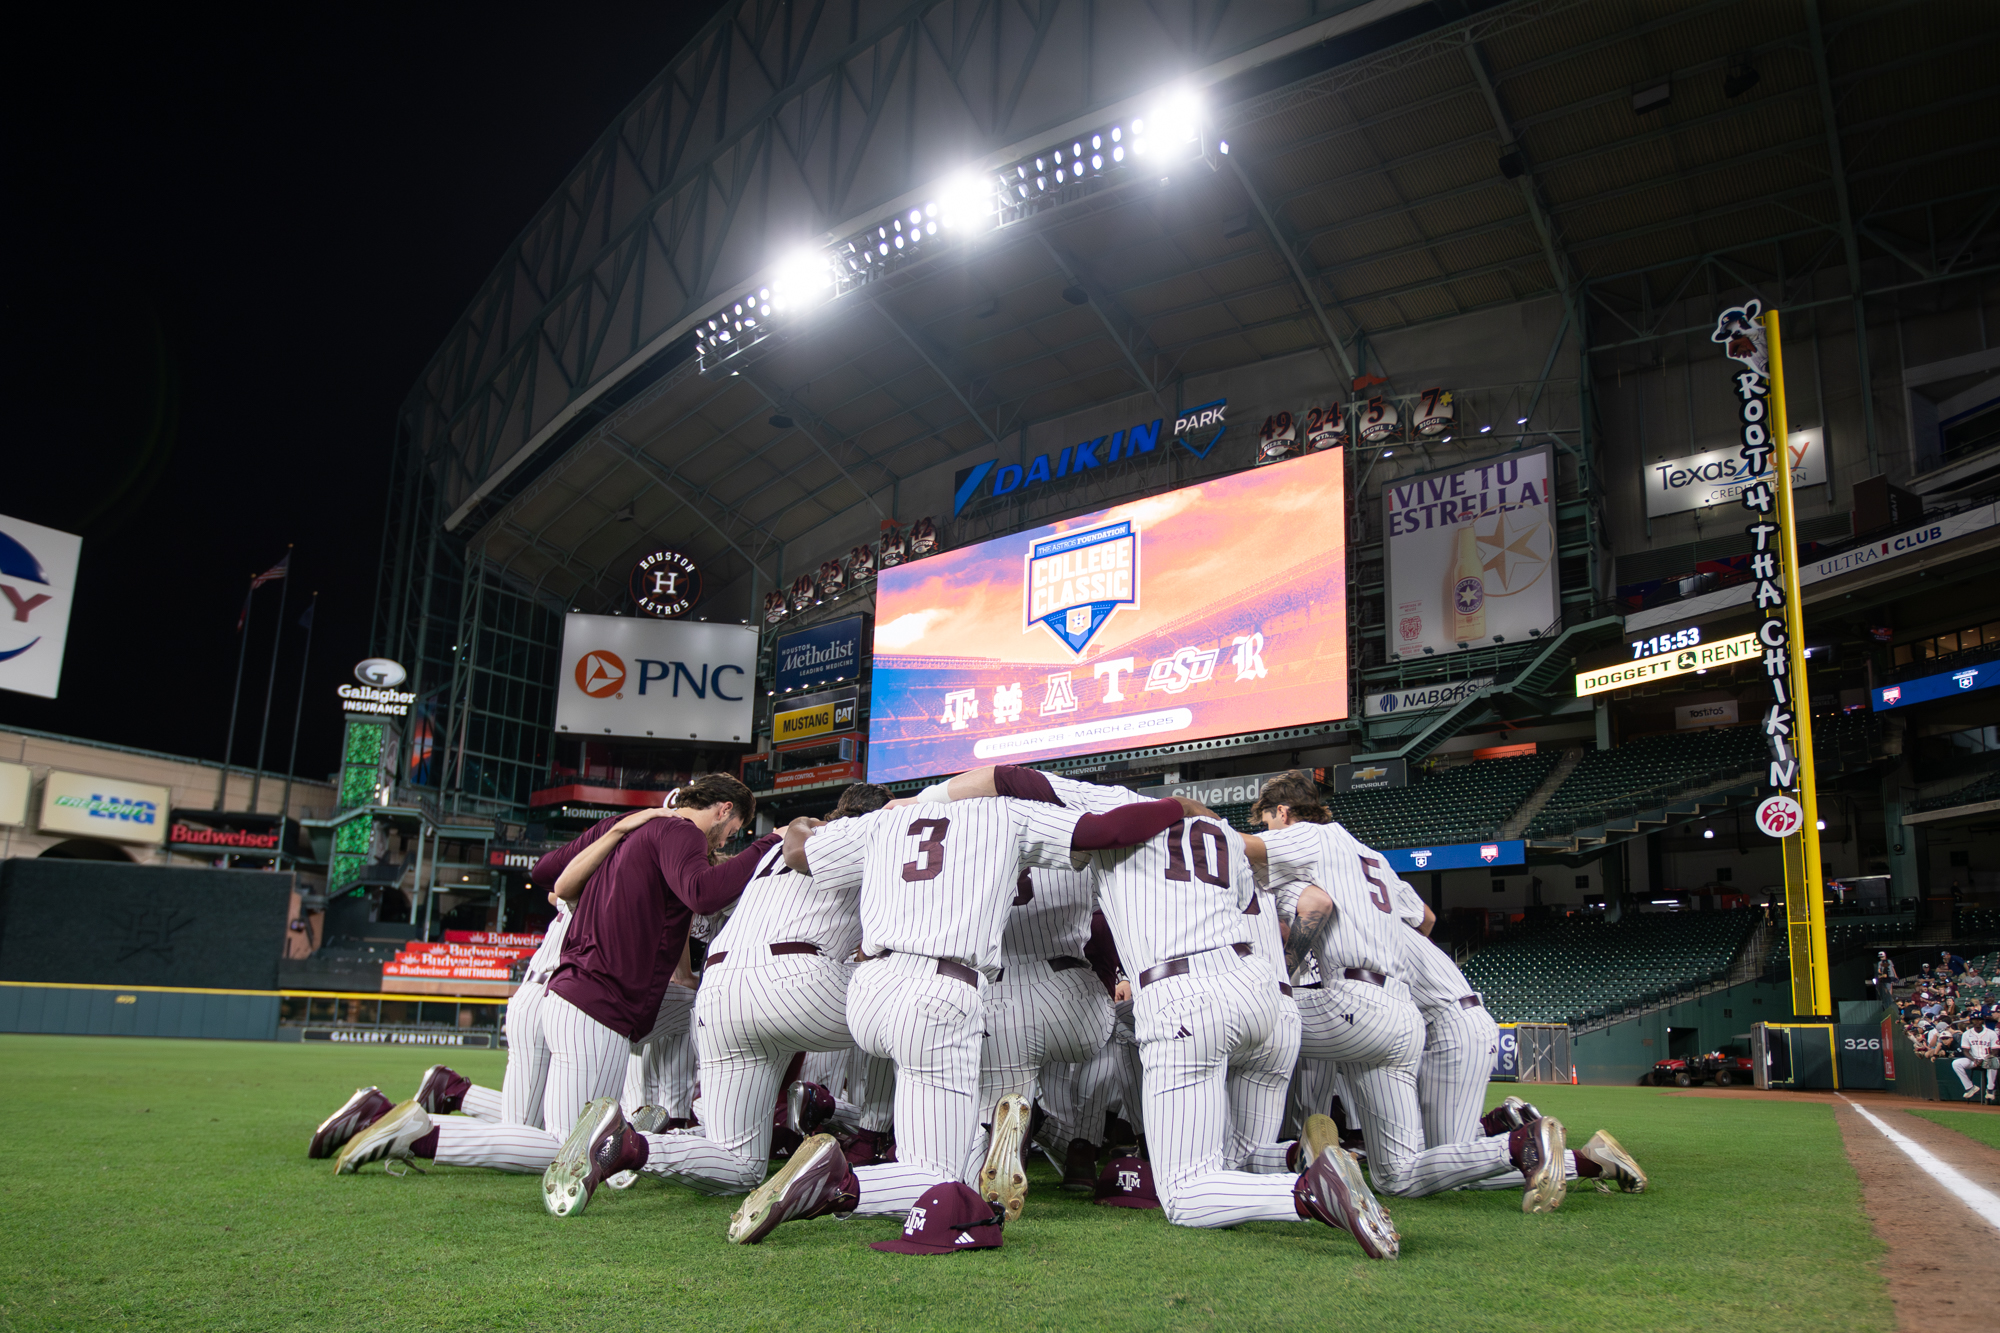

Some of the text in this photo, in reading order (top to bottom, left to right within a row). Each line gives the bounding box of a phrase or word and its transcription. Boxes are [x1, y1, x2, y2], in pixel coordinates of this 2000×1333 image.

[1368, 395, 1385, 424] 5
[1421, 387, 1441, 418] 7
[1173, 405, 1228, 435] PARK
[1259, 411, 1293, 441] 49
[1306, 401, 1342, 434] 24
[1737, 372, 1770, 473] ROOT
[992, 418, 1163, 497] DAIKIN
[1474, 459, 1519, 491] TU
[1656, 459, 1737, 491] Texas
[1390, 478, 1549, 538] ESTRELLA!
[880, 529, 903, 554] 34
[909, 516, 933, 541] 42
[1038, 526, 1127, 555] THE ASTROS FOUNDATION
[639, 552, 696, 573] HOUSTON
[1033, 539, 1130, 588] COLLEGE
[1819, 526, 1942, 576] ULTRA CLUB
[1750, 525, 1783, 609] THA
[652, 571, 679, 595] H
[1033, 569, 1129, 617] CLASSIC
[638, 597, 690, 615] ASTROS
[780, 640, 854, 673] Methodist
[781, 643, 811, 656] HOUSTON
[1631, 627, 1701, 660] 7:15:53
[634, 658, 745, 701] PNC
[799, 659, 854, 677] LEADING MEDICINE
[1585, 660, 1671, 690] DOGGETT
[337, 684, 417, 704] Gallagher
[342, 700, 409, 716] INSURANCE
[1403, 684, 1478, 708] NABORS
[1759, 620, 1795, 787] CHIKIN
[783, 706, 854, 734] MUSTANG CAT
[985, 736, 1046, 752] FEBRUARY
[1048, 733, 1064, 743] 28
[1074, 723, 1121, 738] MARCH
[1138, 716, 1175, 730] 2025
[1065, 764, 1107, 777] CHEVROLET
[1351, 780, 1389, 790] CHEVROLET
[1172, 778, 1267, 805] Silverad
[54, 796, 145, 817] FREEPORT
[170, 824, 279, 849] Budweiser
[902, 817, 951, 883] 3
[1164, 819, 1230, 889] 10
[1358, 854, 1393, 915] 5
[421, 953, 496, 968] Budweiser
[449, 944, 520, 960] Budweiser
[399, 965, 509, 980] Budweiser #HITTHEBUDS
[330, 1031, 464, 1046] GALLERY FURNITURE
[1844, 1038, 1881, 1050] 326
